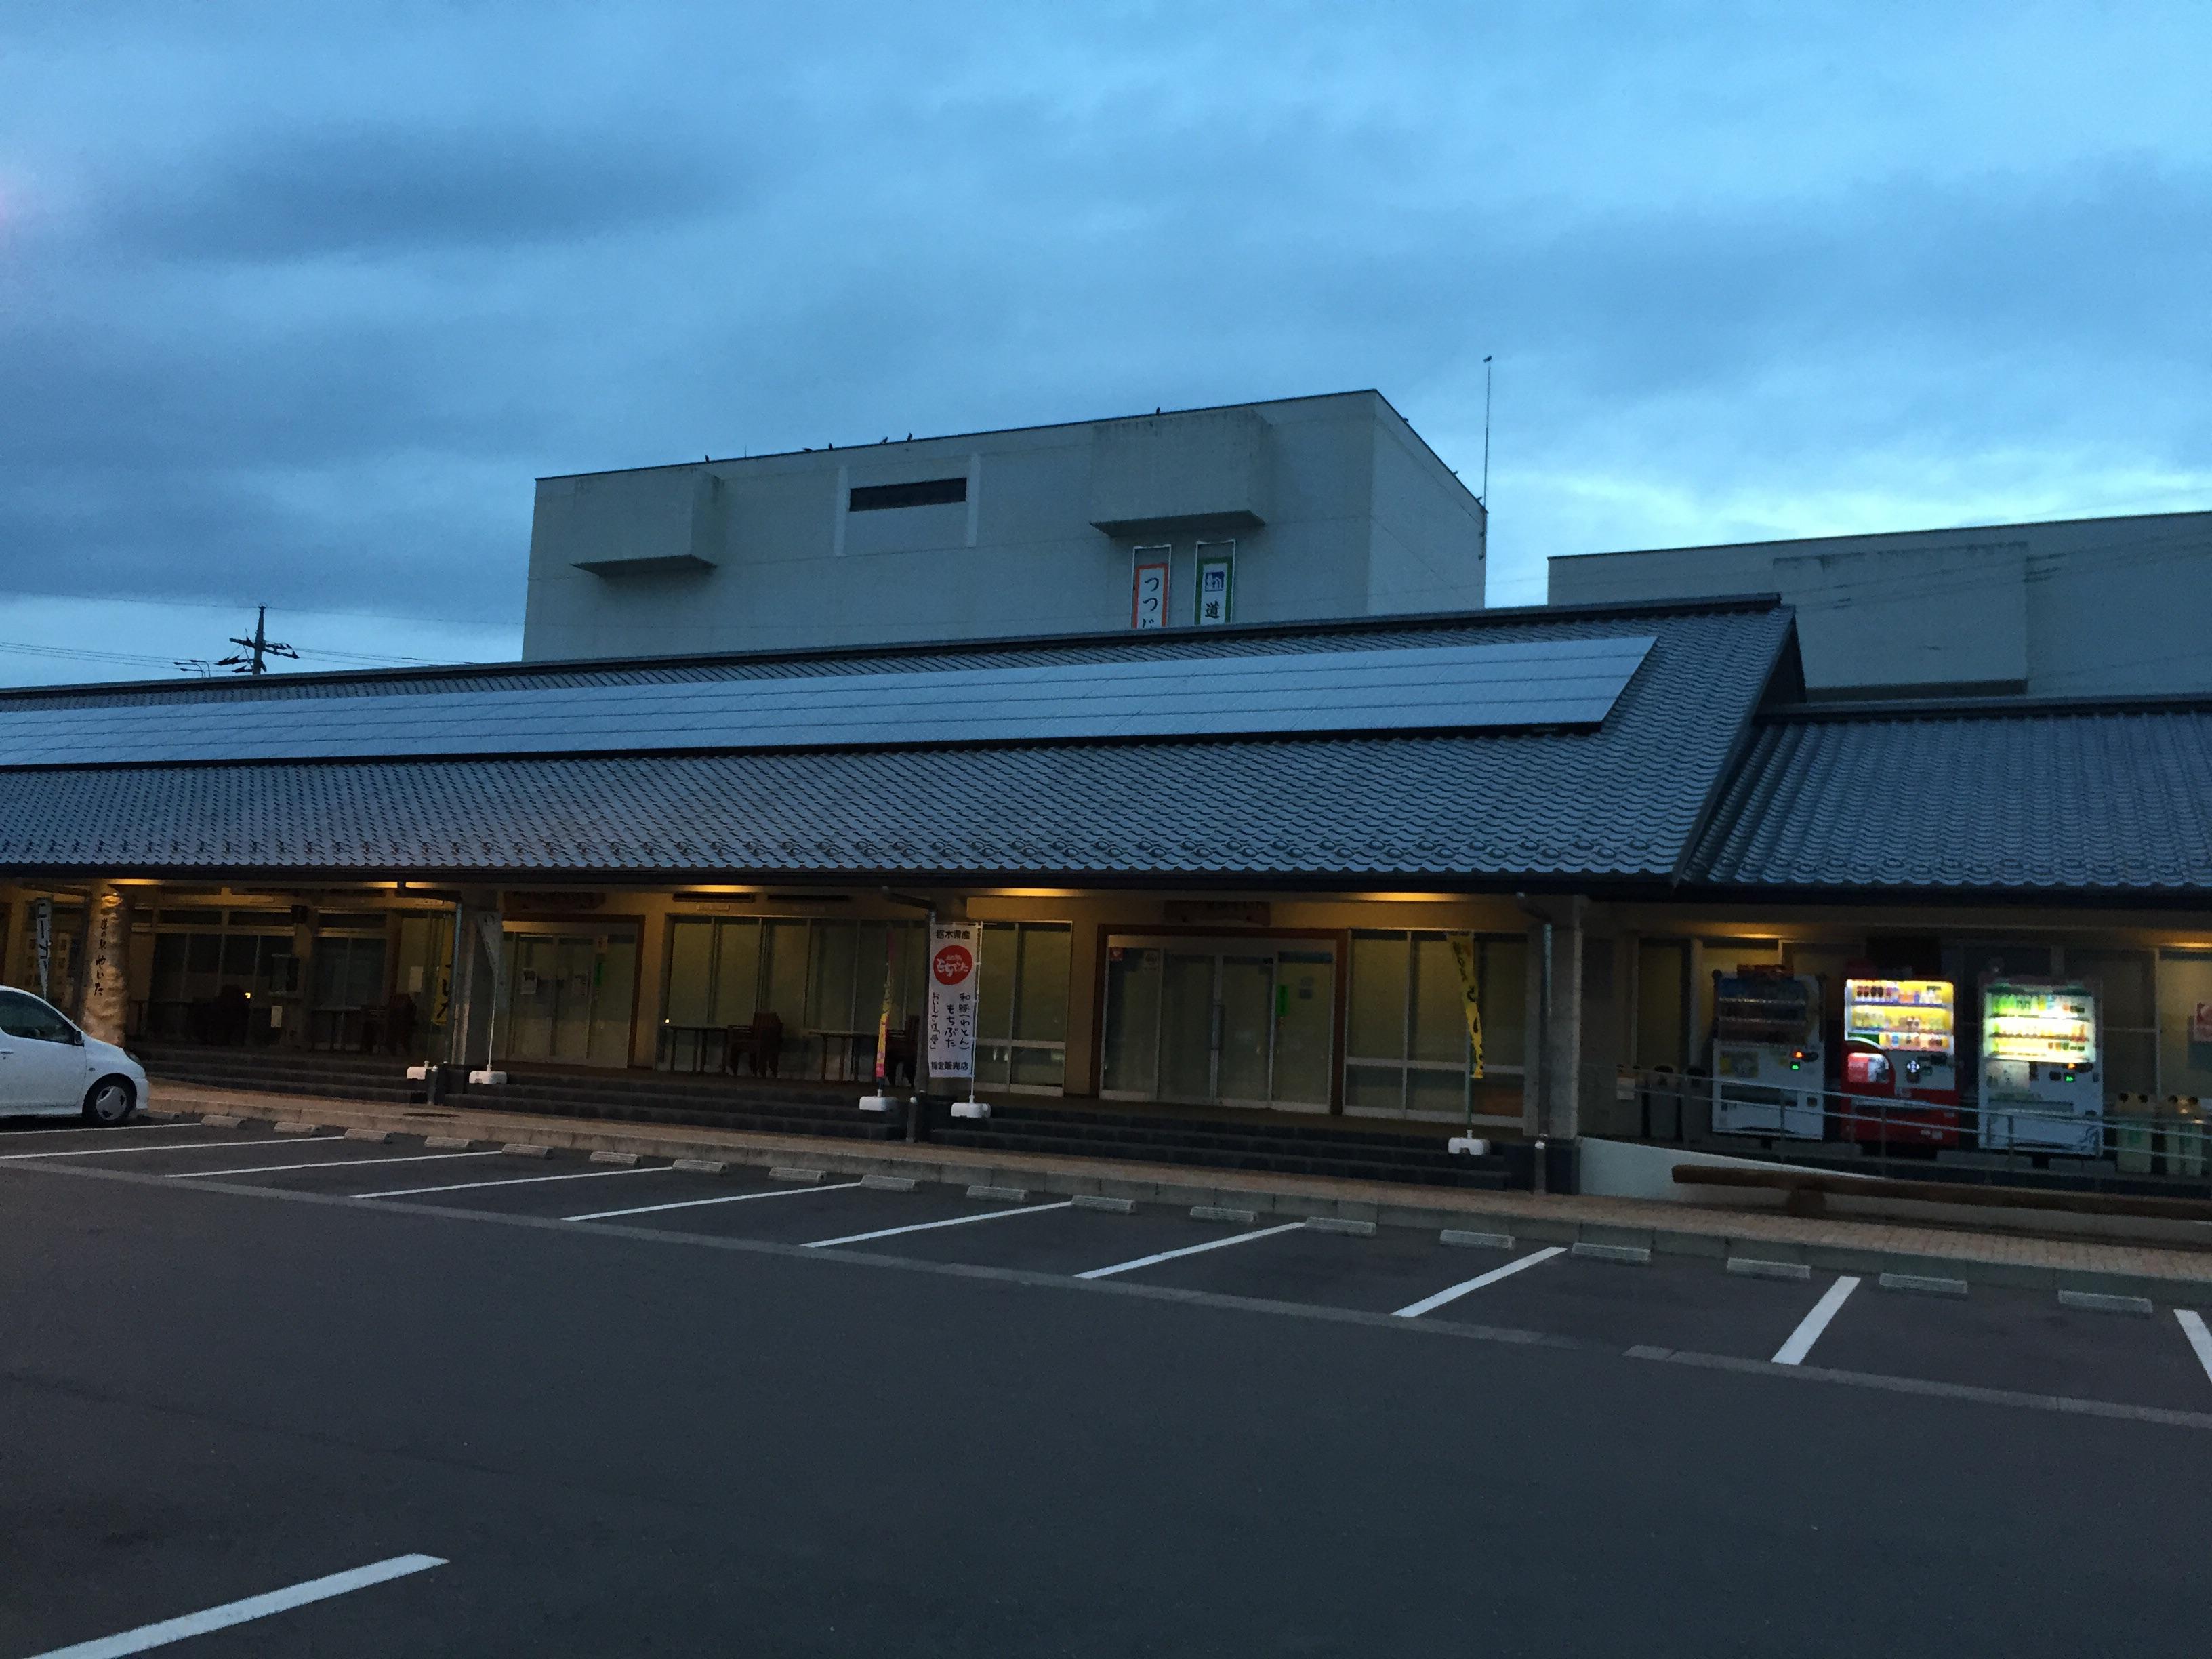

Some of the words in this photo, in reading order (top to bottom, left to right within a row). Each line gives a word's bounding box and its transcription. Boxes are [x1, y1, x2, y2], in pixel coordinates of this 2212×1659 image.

[1204, 600, 1221, 619] 道
[936, 929, 971, 940] 栃木県産
[945, 1004, 958, 1048] もちぶた
